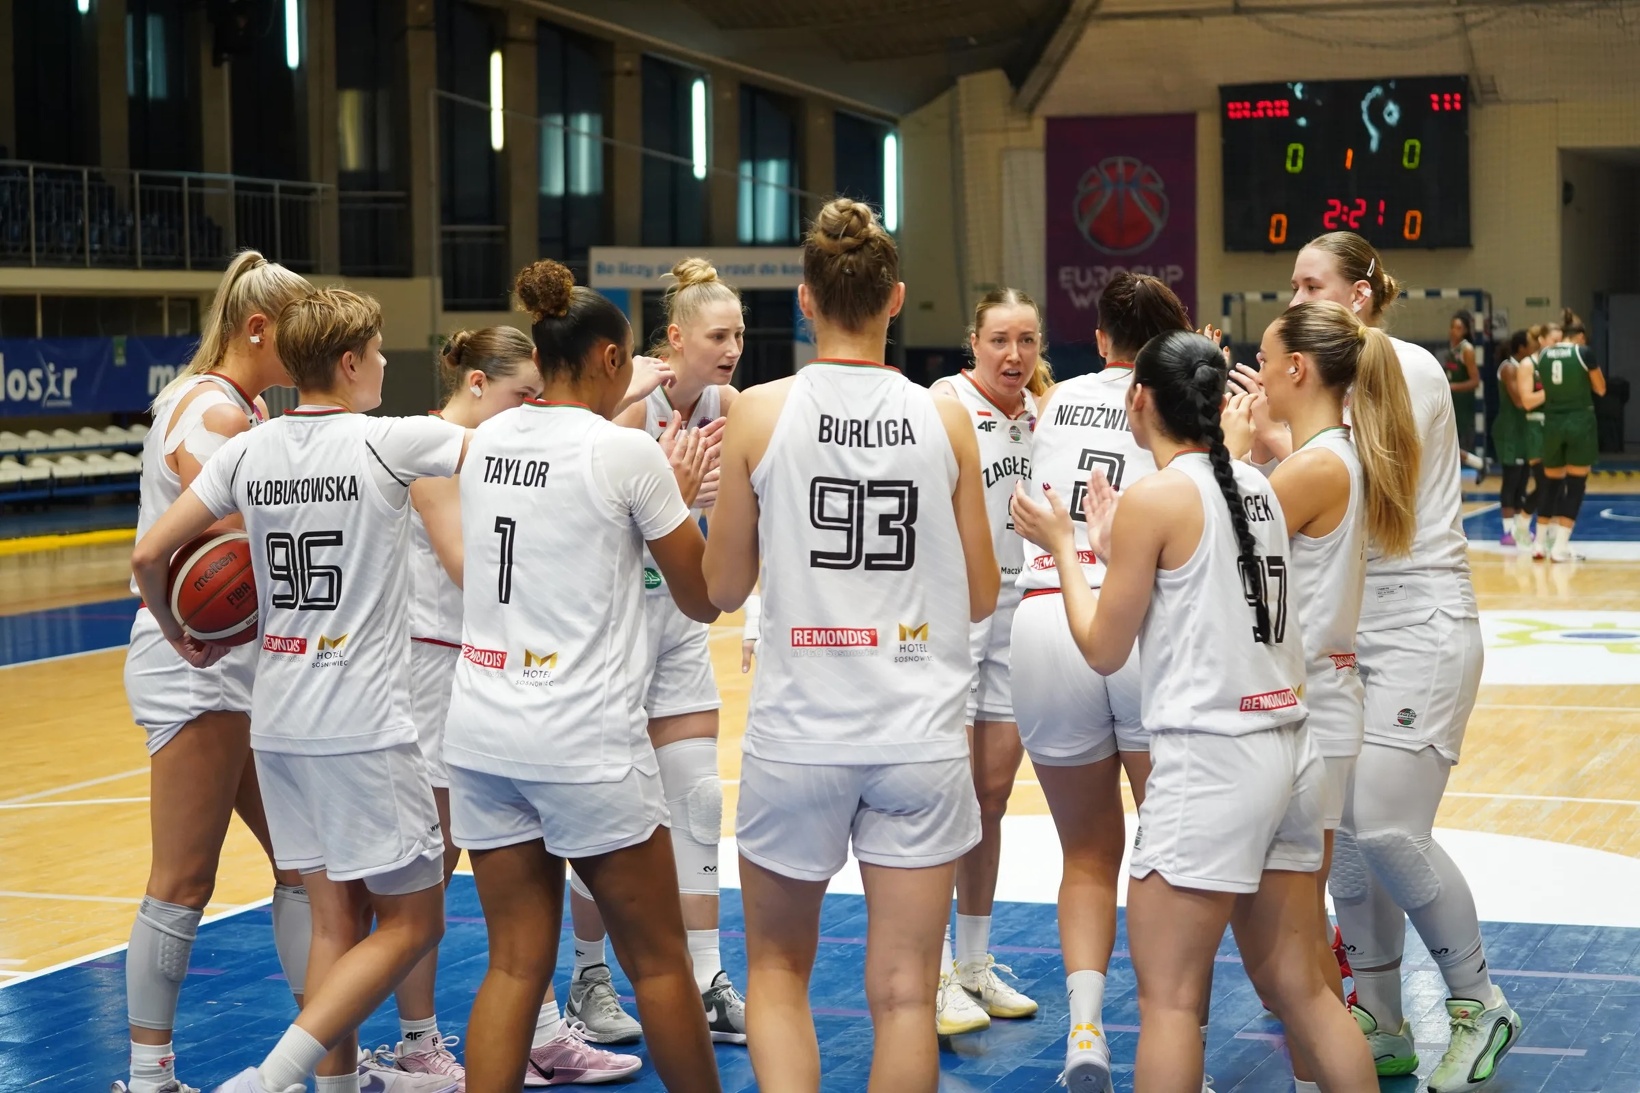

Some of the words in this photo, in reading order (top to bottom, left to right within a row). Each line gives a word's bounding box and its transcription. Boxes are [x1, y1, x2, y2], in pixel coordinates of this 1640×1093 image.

[1285, 142, 1304, 173] 0
[1345, 148, 1353, 170] 1
[1402, 139, 1421, 169] 0
[1269, 213, 1288, 244] 0
[1403, 209, 1422, 240] 0
[818, 414, 916, 448] BURLIGA
[484, 456, 550, 488] TAYLOR
[983, 456, 1032, 488] ZAGŁĘ
[246, 475, 359, 506] KŁOBUKOWSKA
[810, 476, 918, 571] 93
[1244, 494, 1275, 522] CEK
[193, 551, 238, 592] molten
[266, 530, 343, 610] 96
[494, 516, 516, 604] 1
[226, 582, 251, 606] FIBA
[1237, 556, 1287, 643] 97
[793, 630, 872, 645] REMONDIS
[899, 644, 927, 652] HOTEL
[1242, 690, 1295, 710] REMONDIS
